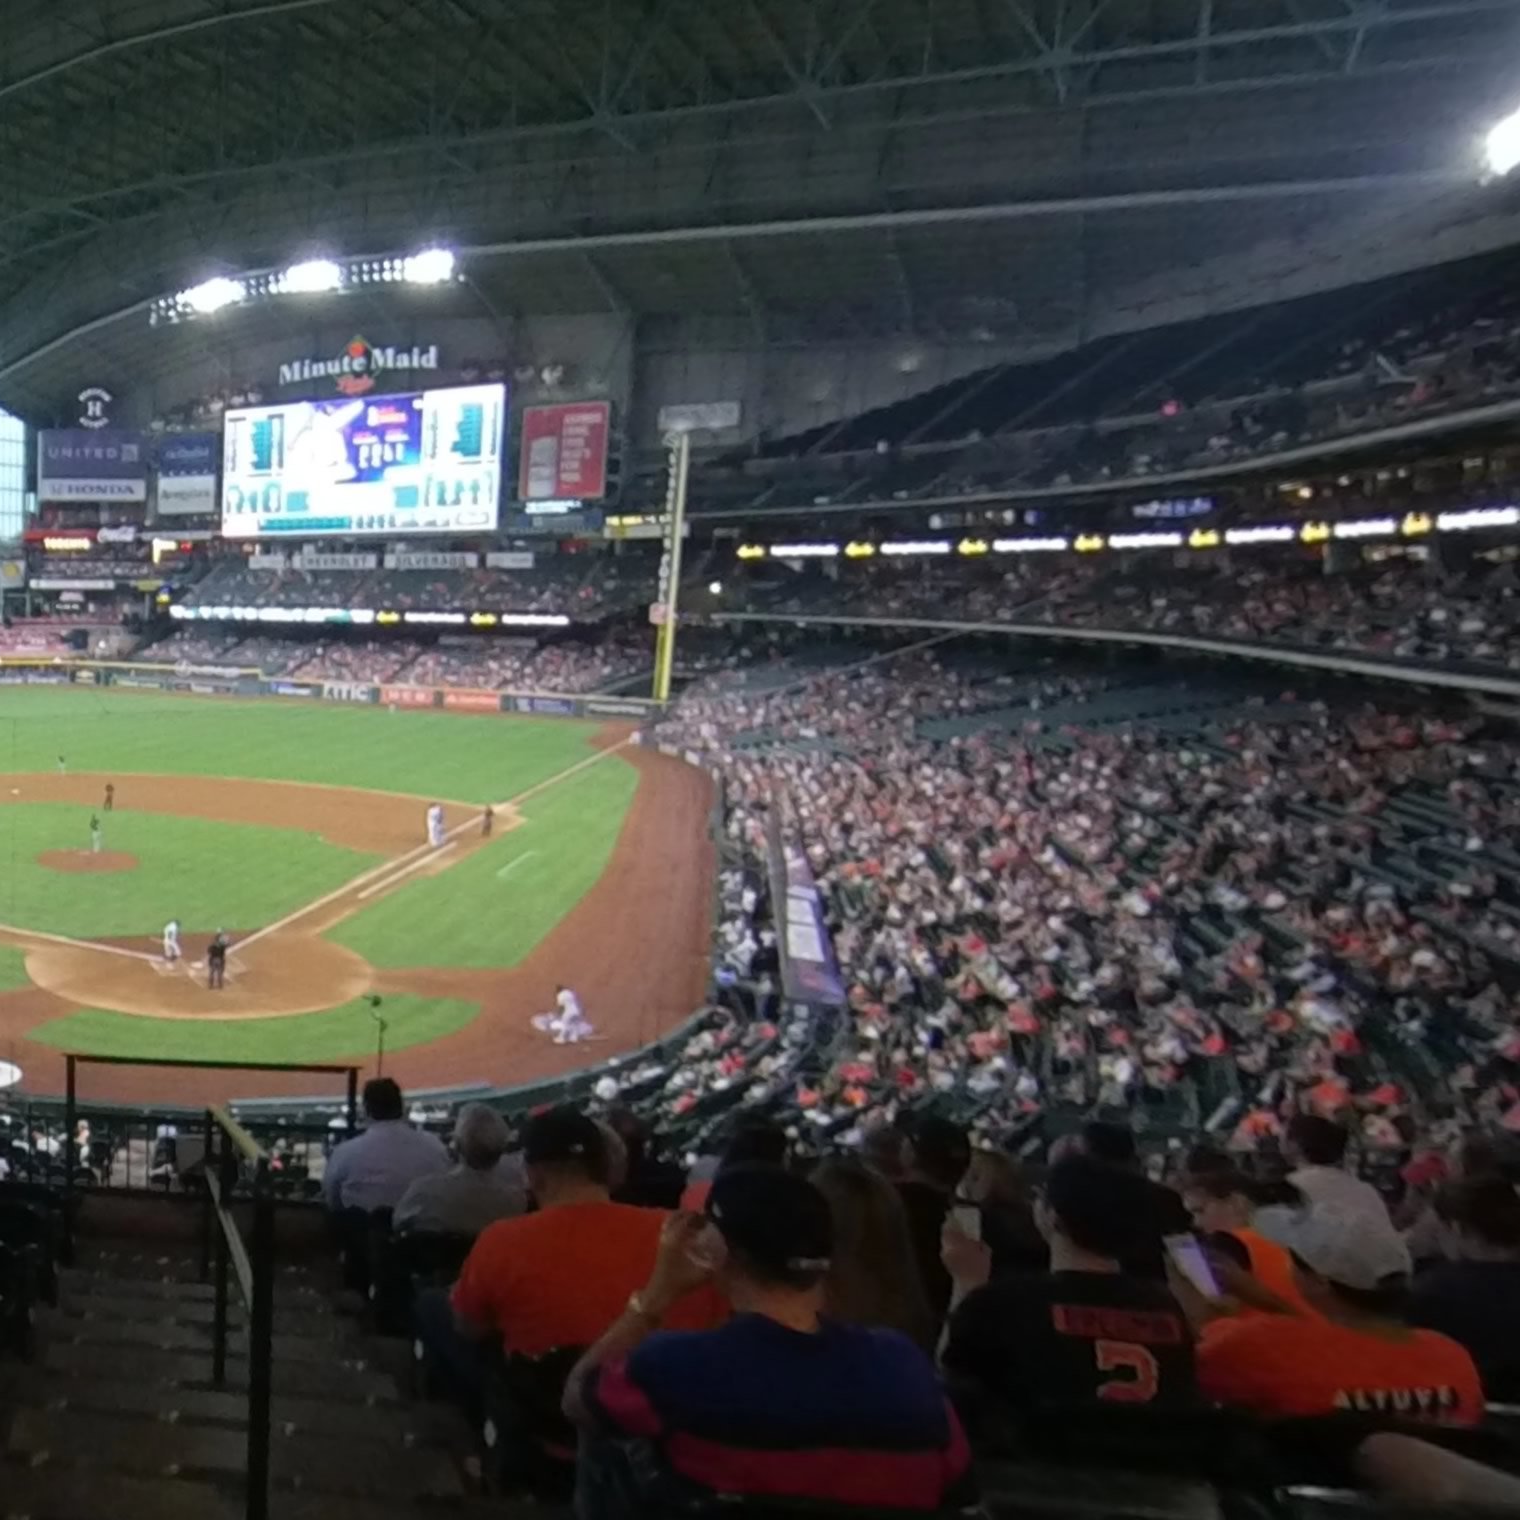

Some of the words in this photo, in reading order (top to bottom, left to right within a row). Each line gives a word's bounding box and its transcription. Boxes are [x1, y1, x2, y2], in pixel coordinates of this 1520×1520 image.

[279, 354, 367, 385] Minute
[370, 346, 437, 369] Maid
[87, 401, 102, 417] H
[47, 447, 118, 459] UNITED
[67, 484, 135, 495] HONDA
[1334, 1385, 1455, 1412] ALTUVE
